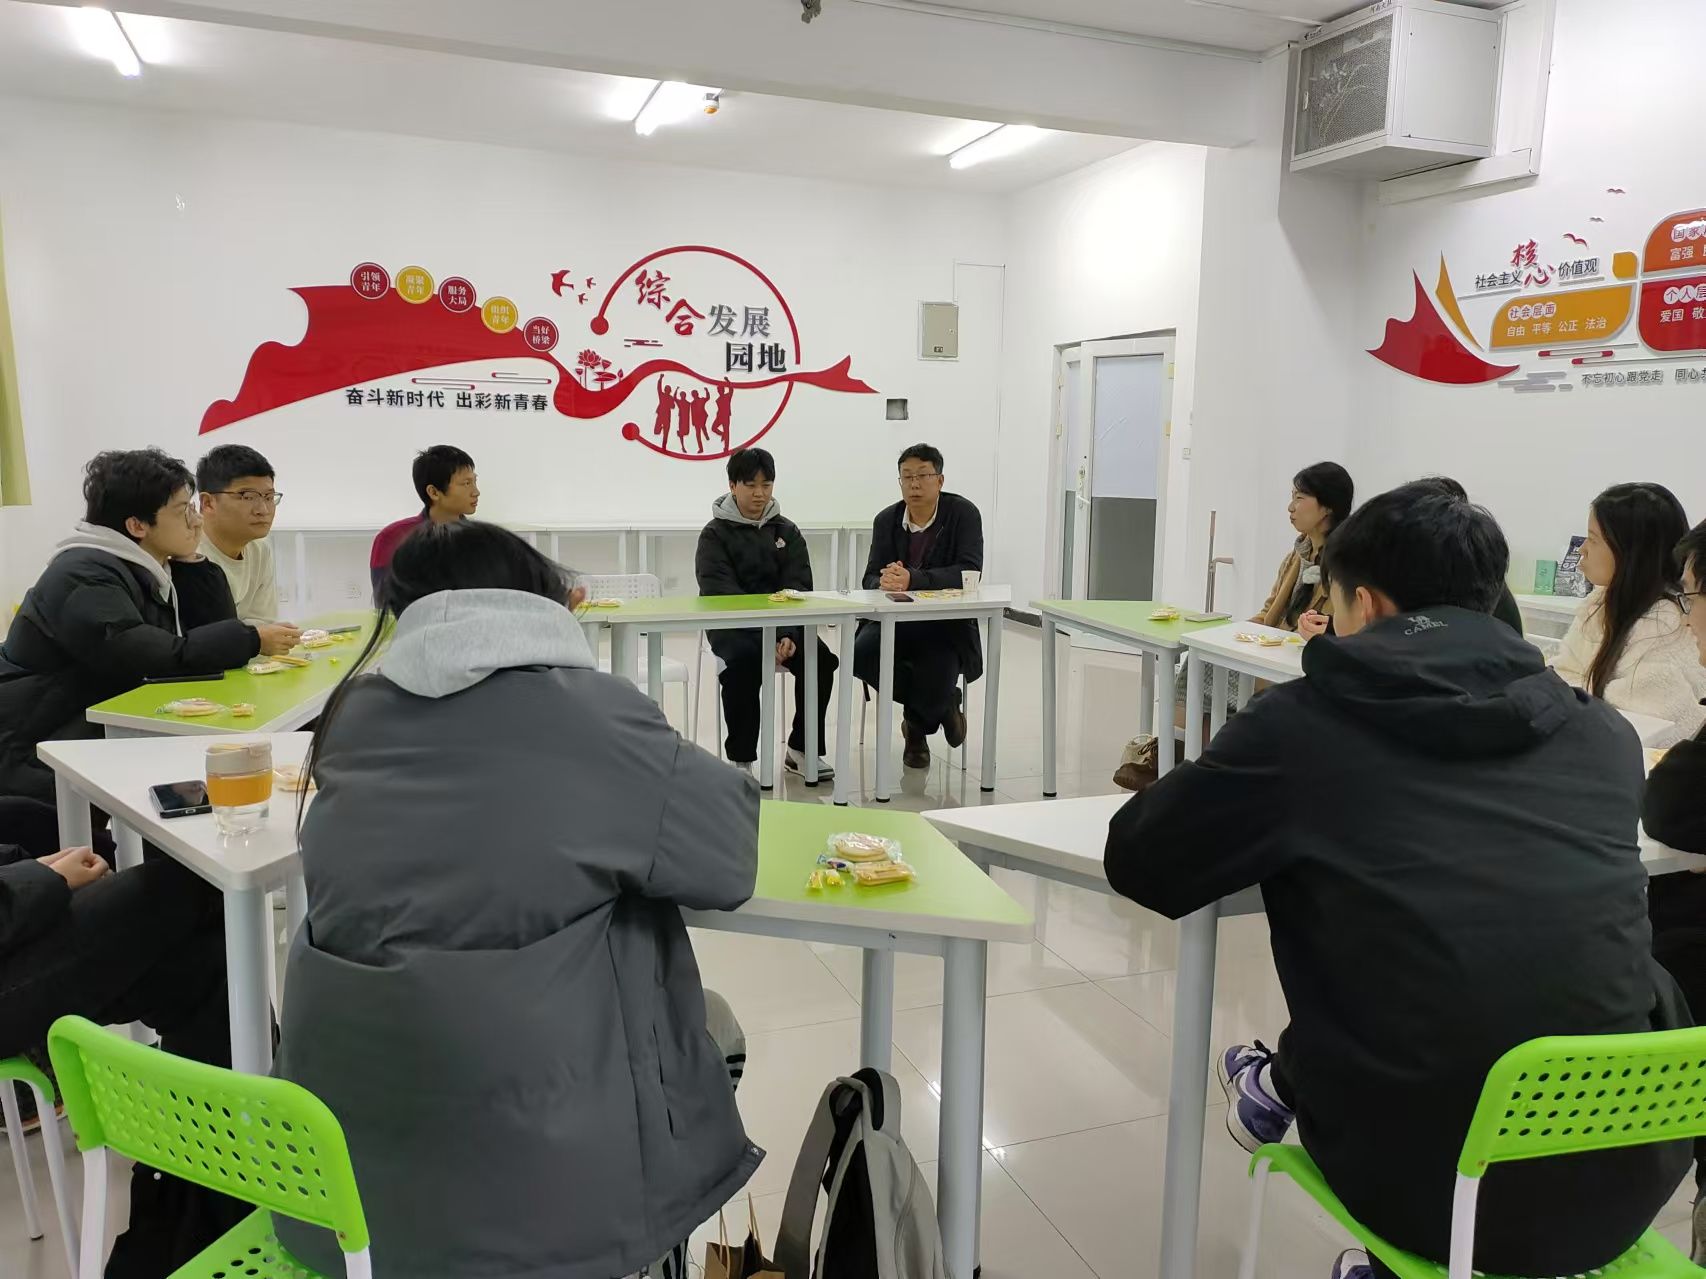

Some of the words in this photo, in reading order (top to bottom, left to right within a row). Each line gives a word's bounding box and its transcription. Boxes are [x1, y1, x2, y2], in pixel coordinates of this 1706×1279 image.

[1670, 246, 1693, 261] 富强
[360, 271, 381, 282] 引领
[362, 282, 381, 292] 青年
[447, 286, 467, 295] 服务
[448, 296, 467, 306] 大局
[1509, 303, 1556, 319] 社会层面
[1660, 309, 1684, 322] 爱国
[1692, 306, 1706, 320] 敬
[532, 325, 550, 335] 当好
[1507, 326, 1525, 337] 自由
[1532, 322, 1553, 334] 平等
[1559, 319, 1579, 332] 公正
[1585, 317, 1608, 329] 法治
[532, 335, 551, 345] 桥梁
[726, 341, 787, 373] 园地
[1581, 369, 1662, 385] 不忘初心跟党走
[345, 388, 445, 408] 奋斗新时代
[456, 392, 549, 411] 出彩新青春
[1404, 621, 1448, 635] CAMEL
